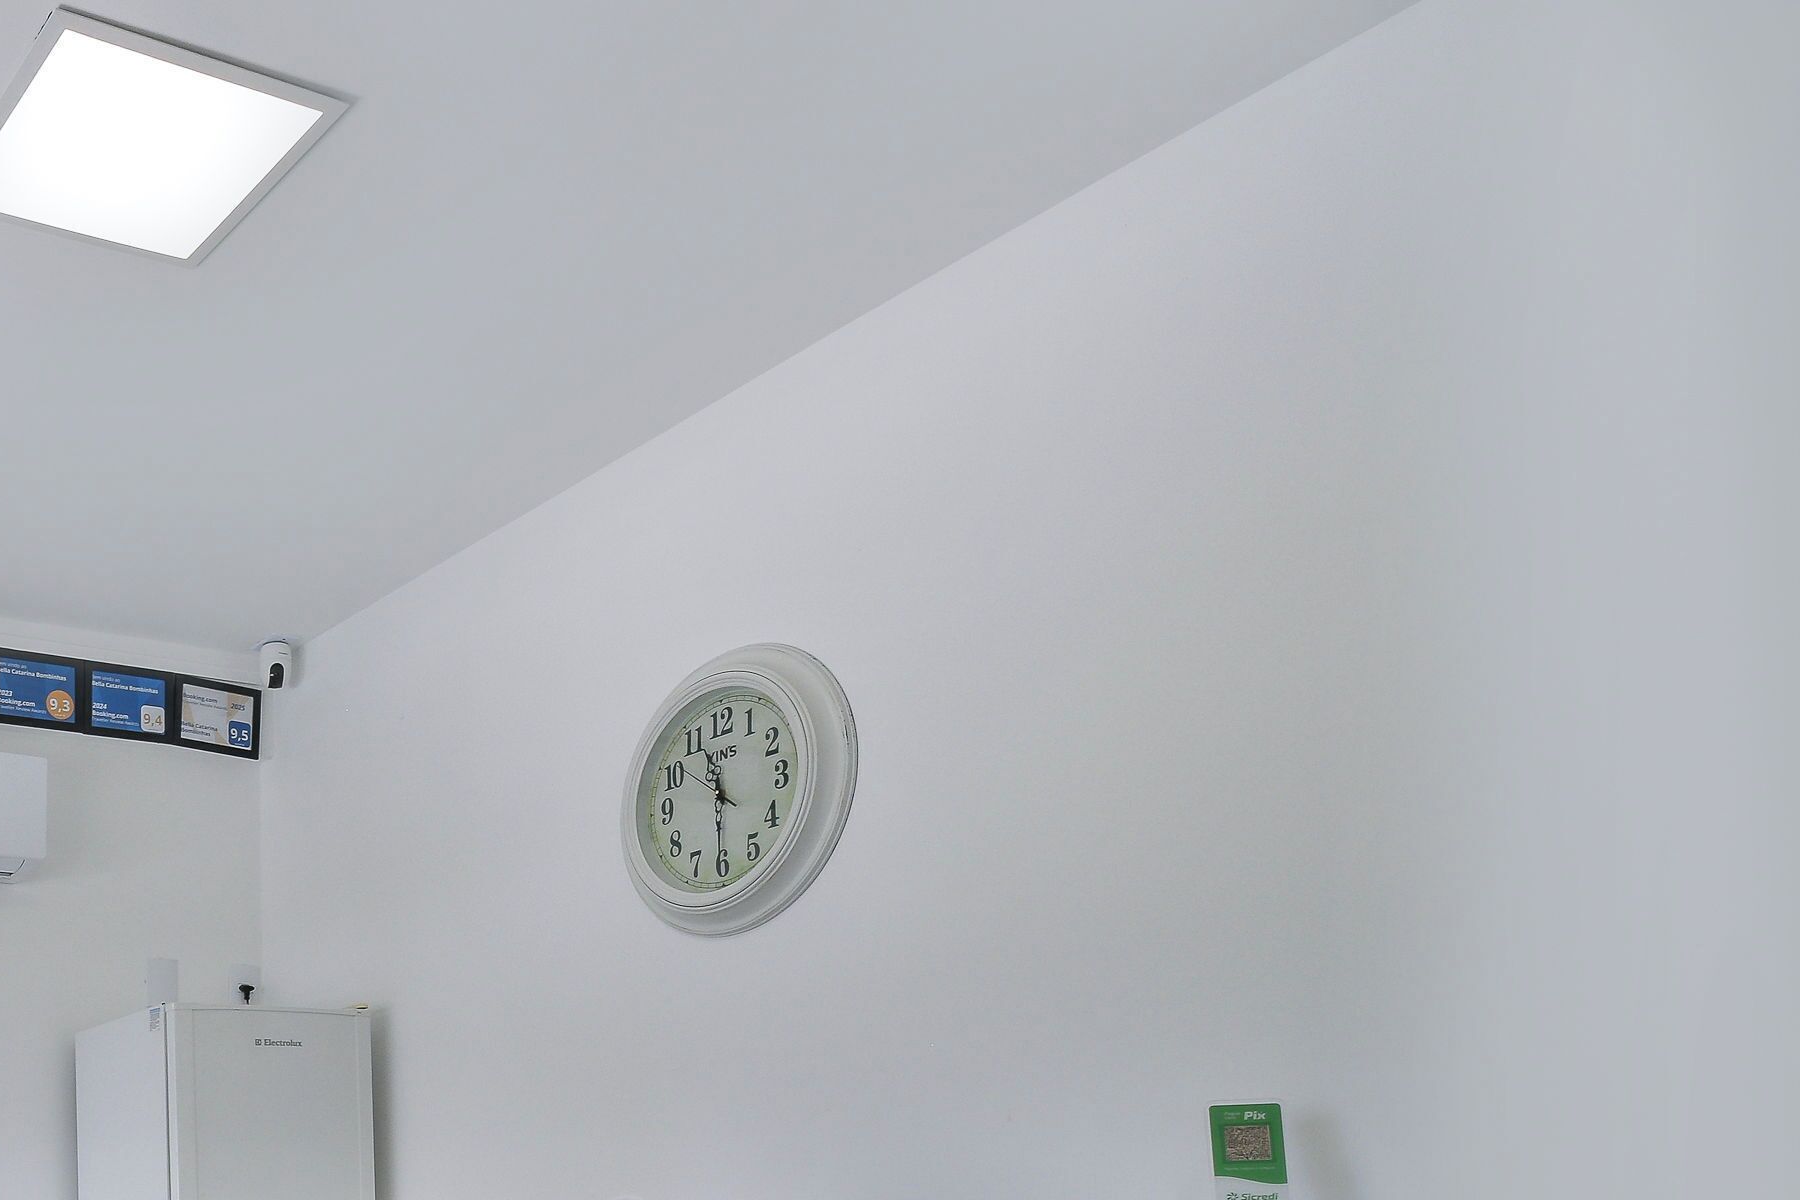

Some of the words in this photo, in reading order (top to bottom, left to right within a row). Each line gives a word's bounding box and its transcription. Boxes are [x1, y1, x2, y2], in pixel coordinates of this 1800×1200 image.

[12, 669, 35, 677] Catarina
[106, 682, 128, 690] Catarina
[50, 698, 70, 712] 9,3
[92, 710, 128, 720] Booking.com
[231, 703, 245, 711] 2025
[143, 714, 162, 727] 9,4
[710, 706, 733, 739] 12
[744, 708, 756, 737] 1
[230, 728, 249, 741] 9,5
[684, 725, 703, 757] 11
[765, 726, 779, 757] 2
[664, 760, 684, 791] 10
[774, 759, 789, 789] 3
[661, 798, 674, 825] 9
[764, 800, 779, 829] 4
[670, 830, 682, 857] 8
[746, 832, 760, 861] 5
[690, 850, 702, 877] 7
[716, 849, 729, 877] 6
[1244, 1110, 1266, 1120] Pix
[1241, 1193, 1278, 1200] Sicredi
